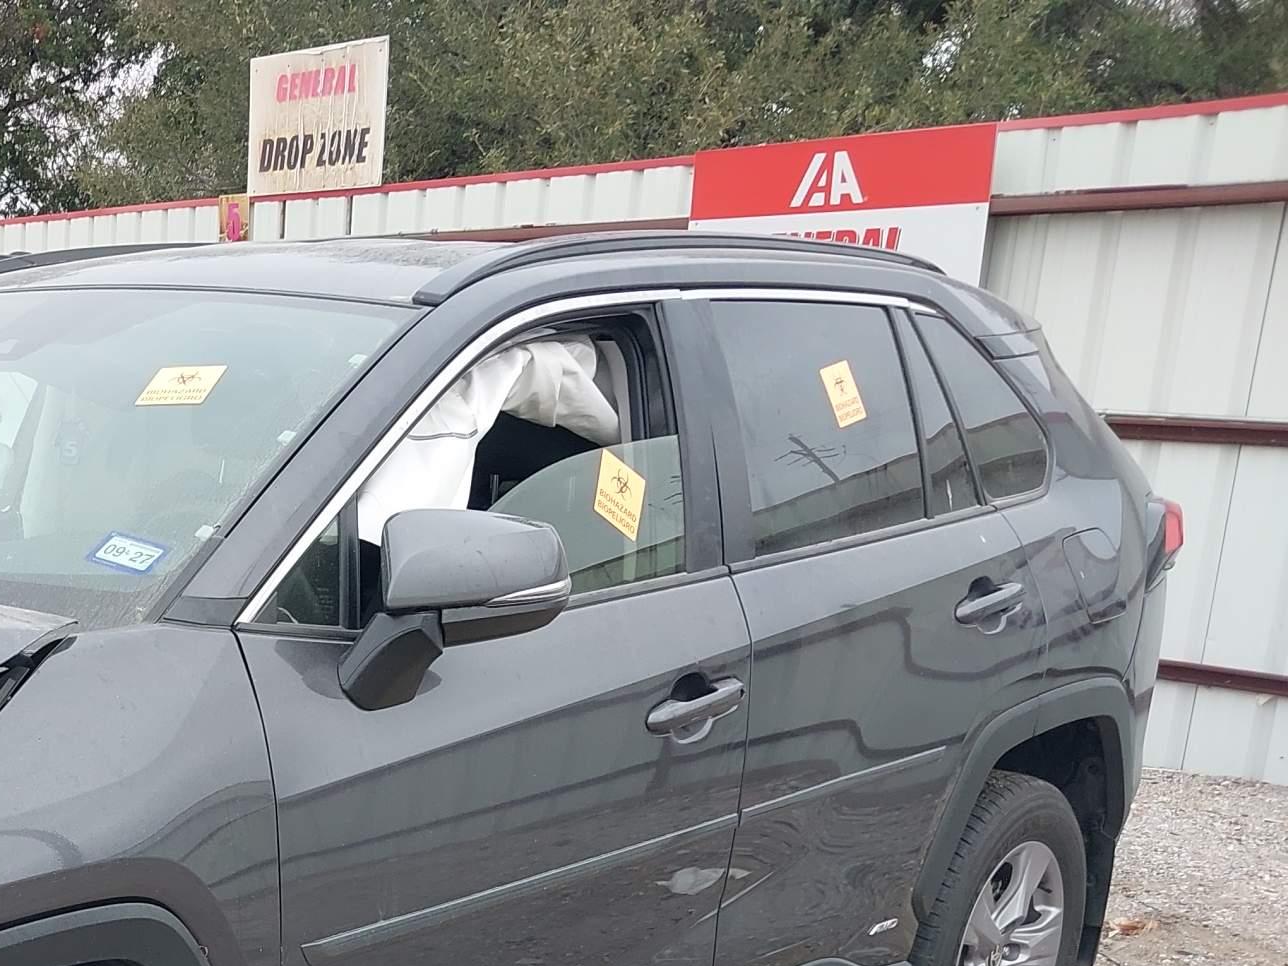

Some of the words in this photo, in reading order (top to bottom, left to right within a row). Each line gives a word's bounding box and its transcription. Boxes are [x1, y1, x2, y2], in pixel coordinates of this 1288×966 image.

[276, 63, 356, 103] GENERAL
[258, 132, 314, 173] DROP
[315, 127, 371, 168] ZONE
[598, 499, 635, 534] BIOPELIGRO
[599, 488, 636, 523] BIOHAZARD
